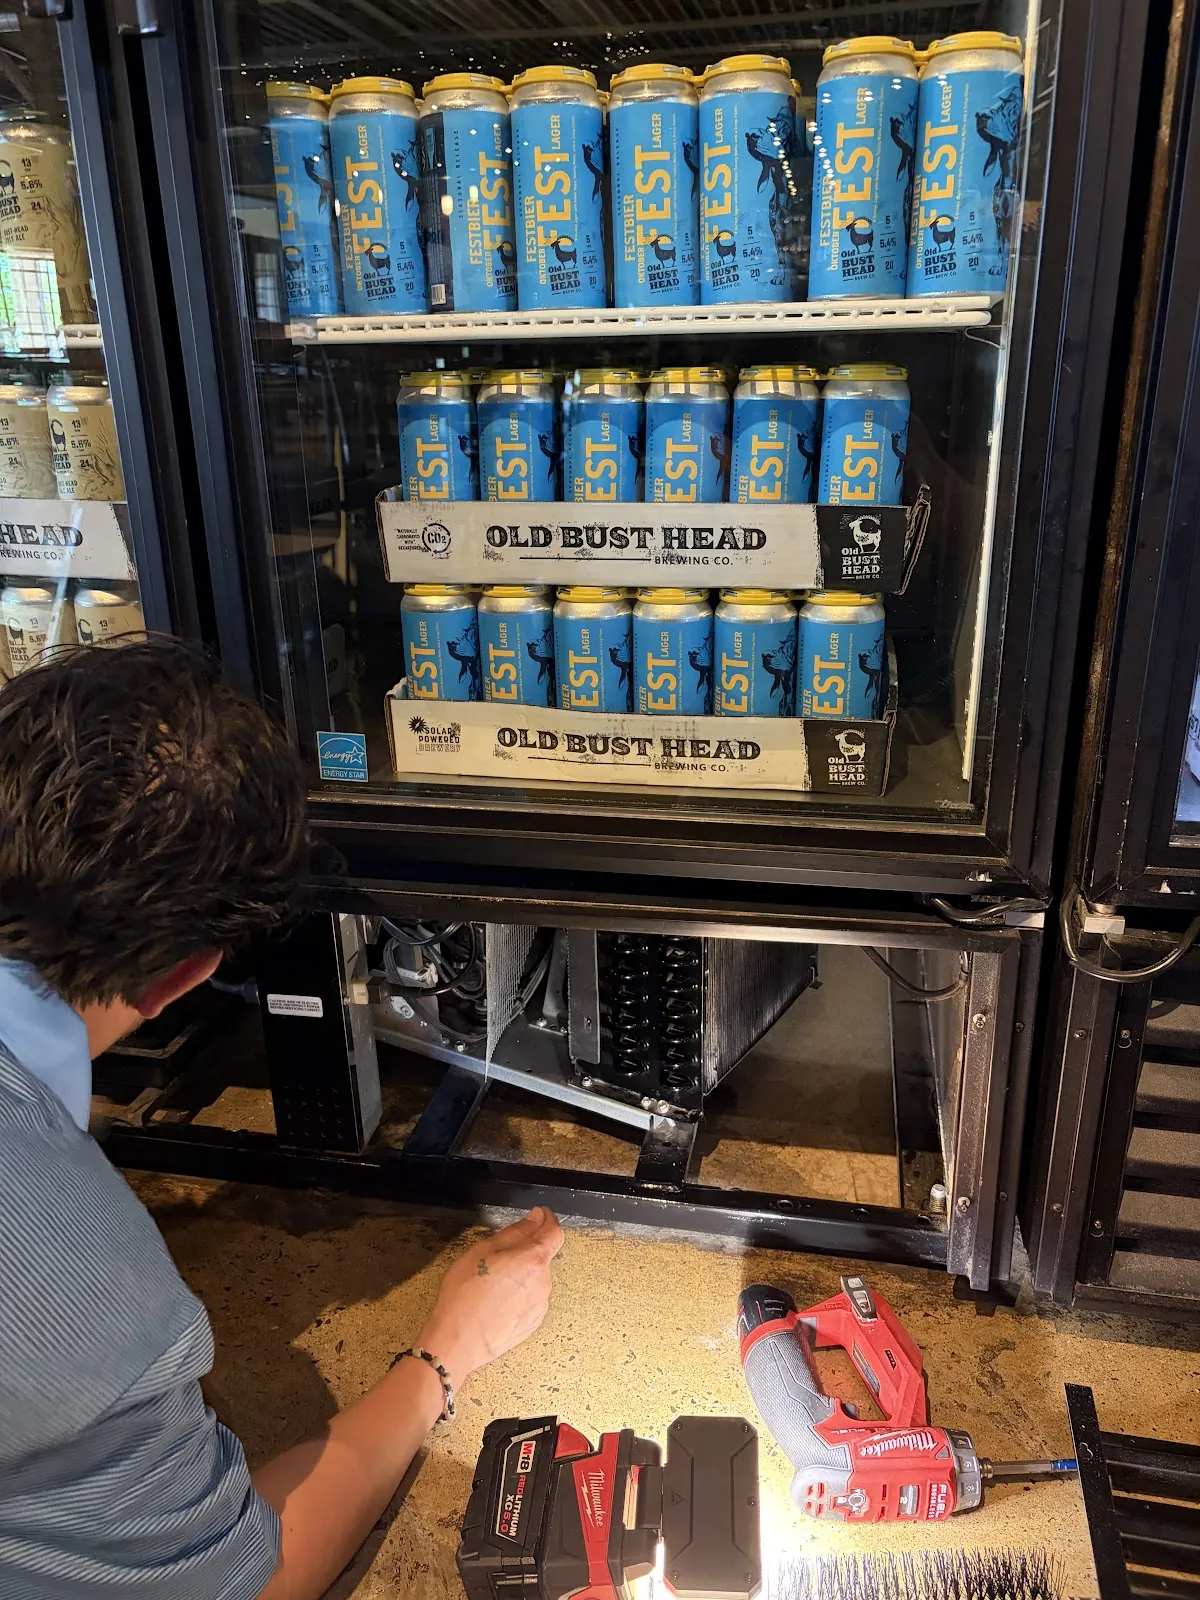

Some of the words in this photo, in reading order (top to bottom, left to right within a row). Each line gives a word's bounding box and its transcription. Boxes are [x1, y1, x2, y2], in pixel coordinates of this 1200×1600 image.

[856, 87, 867, 125] LAGER
[940, 84, 952, 123] LAGER
[551, 114, 560, 150] LAGER
[652, 113, 662, 148] LAGER
[714, 108, 724, 144] LAGER
[358, 125, 368, 160] LAGER
[22, 158, 32, 168] 13
[832, 122, 875, 229] FEST
[918, 120, 958, 230] FEST
[345, 156, 386, 254] FEST
[478, 152, 512, 250] FEST
[534, 146, 573, 247] FEST
[634, 145, 672, 246] FEST
[704, 142, 732, 244] FEST
[818, 174, 834, 248] FESTBIER
[885, 216, 891, 226] 5
[968, 211, 975, 221] 5
[342, 204, 353, 270] FESTBIER
[467, 196, 482, 264] FESTBIER
[524, 196, 536, 263] FESTBIER
[624, 194, 636, 262] FESTBIER
[748, 226, 753, 236] 5
[830, 232, 840, 270] OKTOBER
[840, 250, 856, 258] Old
[879, 237, 896, 248] 5.4%
[916, 230, 924, 270] OKTOBER
[924, 249, 937, 257] Old
[486, 251, 494, 288] OKTOBER
[538, 248, 547, 285] OKTOBER
[548, 266, 562, 274] Old
[638, 247, 646, 284] OKTOBER
[647, 264, 660, 272] Old
[710, 260, 722, 269] Old
[712, 264, 739, 278] BUST
[750, 268, 761, 278] 20
[841, 254, 875, 268] BUST
[842, 266, 876, 278] HEAD
[884, 260, 894, 270] 20
[924, 252, 956, 267] BUST
[924, 262, 957, 277] HEAD
[968, 258, 979, 268] 20
[356, 256, 364, 291] OKTOBER
[364, 272, 376, 280] Old
[364, 277, 394, 290] BUST
[549, 270, 580, 282] BUST
[550, 280, 581, 292] HEAD
[648, 268, 679, 282] BUST
[650, 278, 680, 290] HEAD
[712, 274, 740, 288] HEAD
[366, 286, 396, 298] HEAD
[72, 420, 81, 428] 13
[430, 412, 438, 442] LAGER
[510, 412, 518, 441] LAGER
[601, 412, 610, 442] LAGER
[682, 412, 692, 442] LAGER
[768, 409, 778, 439] LAGER
[863, 409, 874, 439] LAGER
[70, 440, 91, 448] 5.6%
[80, 460, 90, 468] 21
[416, 438, 448, 499] EST
[496, 437, 528, 499] EST
[584, 438, 617, 500] EST
[664, 438, 698, 502] EST
[750, 434, 784, 500] EST
[842, 434, 880, 501] EST
[410, 476, 418, 502] BIER
[488, 476, 497, 502] BIER
[574, 477, 583, 502] BIER
[738, 475, 748, 503] BIER
[829, 476, 842, 504] BIER
[0, 524, 83, 546] HEAD
[486, 525, 552, 548] OLD
[560, 526, 654, 550] BUST
[662, 527, 767, 550] HEAD
[44, 550, 60, 560] CO.
[654, 556, 712, 566] BREWING
[714, 556, 734, 566] CO.
[842, 547, 858, 556] Old
[842, 555, 881, 566] BUST
[842, 565, 881, 575] HEAD
[100, 620, 108, 628] 13
[418, 620, 428, 647] LAGER
[499, 622, 508, 648] LAGER
[580, 628, 590, 655] LAGER
[660, 631, 670, 658] LAGER
[734, 632, 742, 658] LAGER
[830, 632, 839, 660] LAGER
[410, 642, 439, 700] EST
[488, 644, 518, 700] EST
[568, 650, 599, 708] EST
[646, 652, 677, 710] EST
[722, 652, 749, 713] EST
[562, 684, 570, 710] BIER
[812, 655, 846, 715] EST
[802, 689, 812, 716] BIER
[418, 736, 460, 744] POWERED
[425, 726, 453, 735] SOLAR
[497, 727, 558, 750] OLD
[566, 733, 654, 756] BUST
[660, 738, 761, 761] HEAD
[654, 762, 708, 772] BREWING
[710, 763, 729, 772] CO.
[828, 756, 845, 764] Old
[828, 764, 864, 773] BUST
[324, 770, 348, 778] ENERGY
[828, 773, 866, 782] HEAD
[520, 1442, 534, 1470] M18
[858, 1431, 938, 1457] Milwaukee
[509, 1475, 526, 1536] REDLITHIUM
[588, 1468, 606, 1527] Milwaukee
[936, 1484, 947, 1518] FUEL
